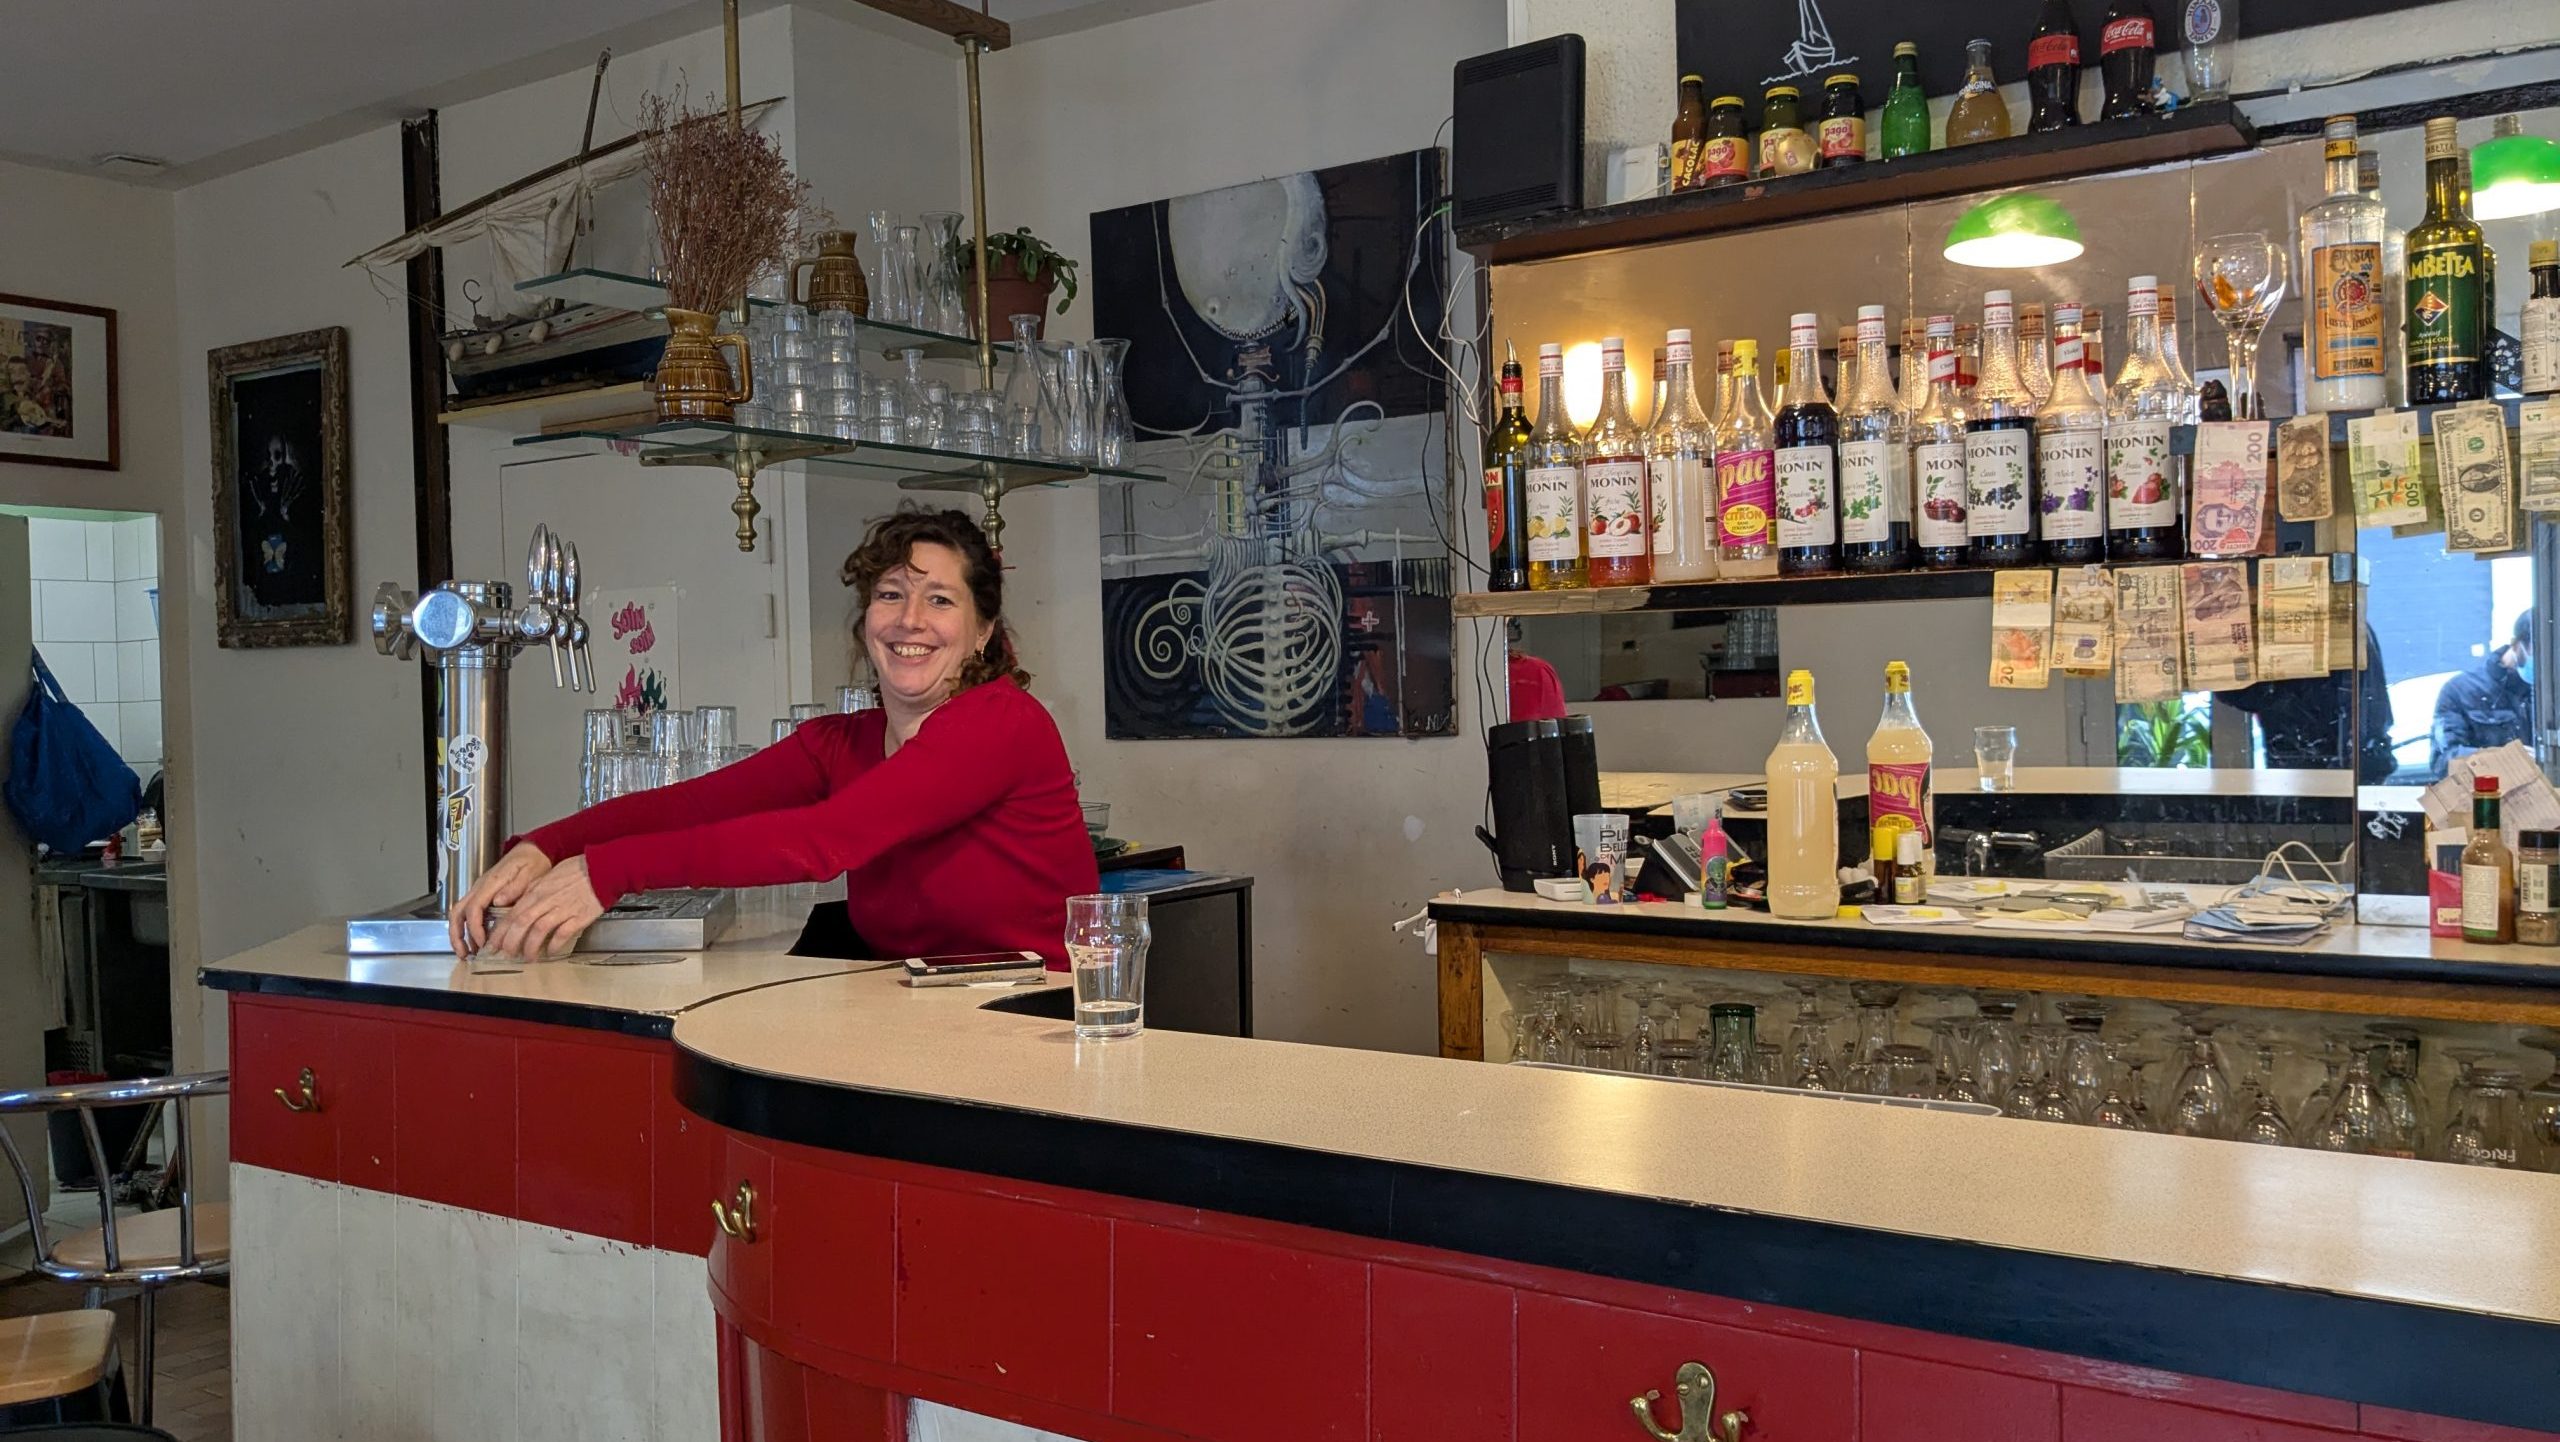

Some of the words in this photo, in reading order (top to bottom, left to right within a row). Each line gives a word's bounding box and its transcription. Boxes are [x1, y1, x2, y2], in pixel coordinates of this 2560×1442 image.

[1824, 126, 1849, 141] pago
[1708, 145, 1728, 159] pago
[1682, 141, 1700, 187] CACOLAC
[2406, 252, 2475, 280] AMBETTA
[2110, 435, 2164, 450] MONIN
[2247, 432, 2262, 463] 200
[1967, 444, 2018, 459] MONIN
[2040, 447, 2093, 462] MONIN
[1776, 461, 1823, 474] MONIN
[1843, 456, 1875, 468] ONIN
[1926, 459, 1966, 471] MON
[1590, 476, 1637, 488] MONIN
[1719, 455, 1768, 501] pac
[1526, 481, 1568, 493] MONIN
[2405, 482, 2420, 507] 500
[1725, 511, 1762, 521] CITRON
[2000, 666, 2014, 685] 20
